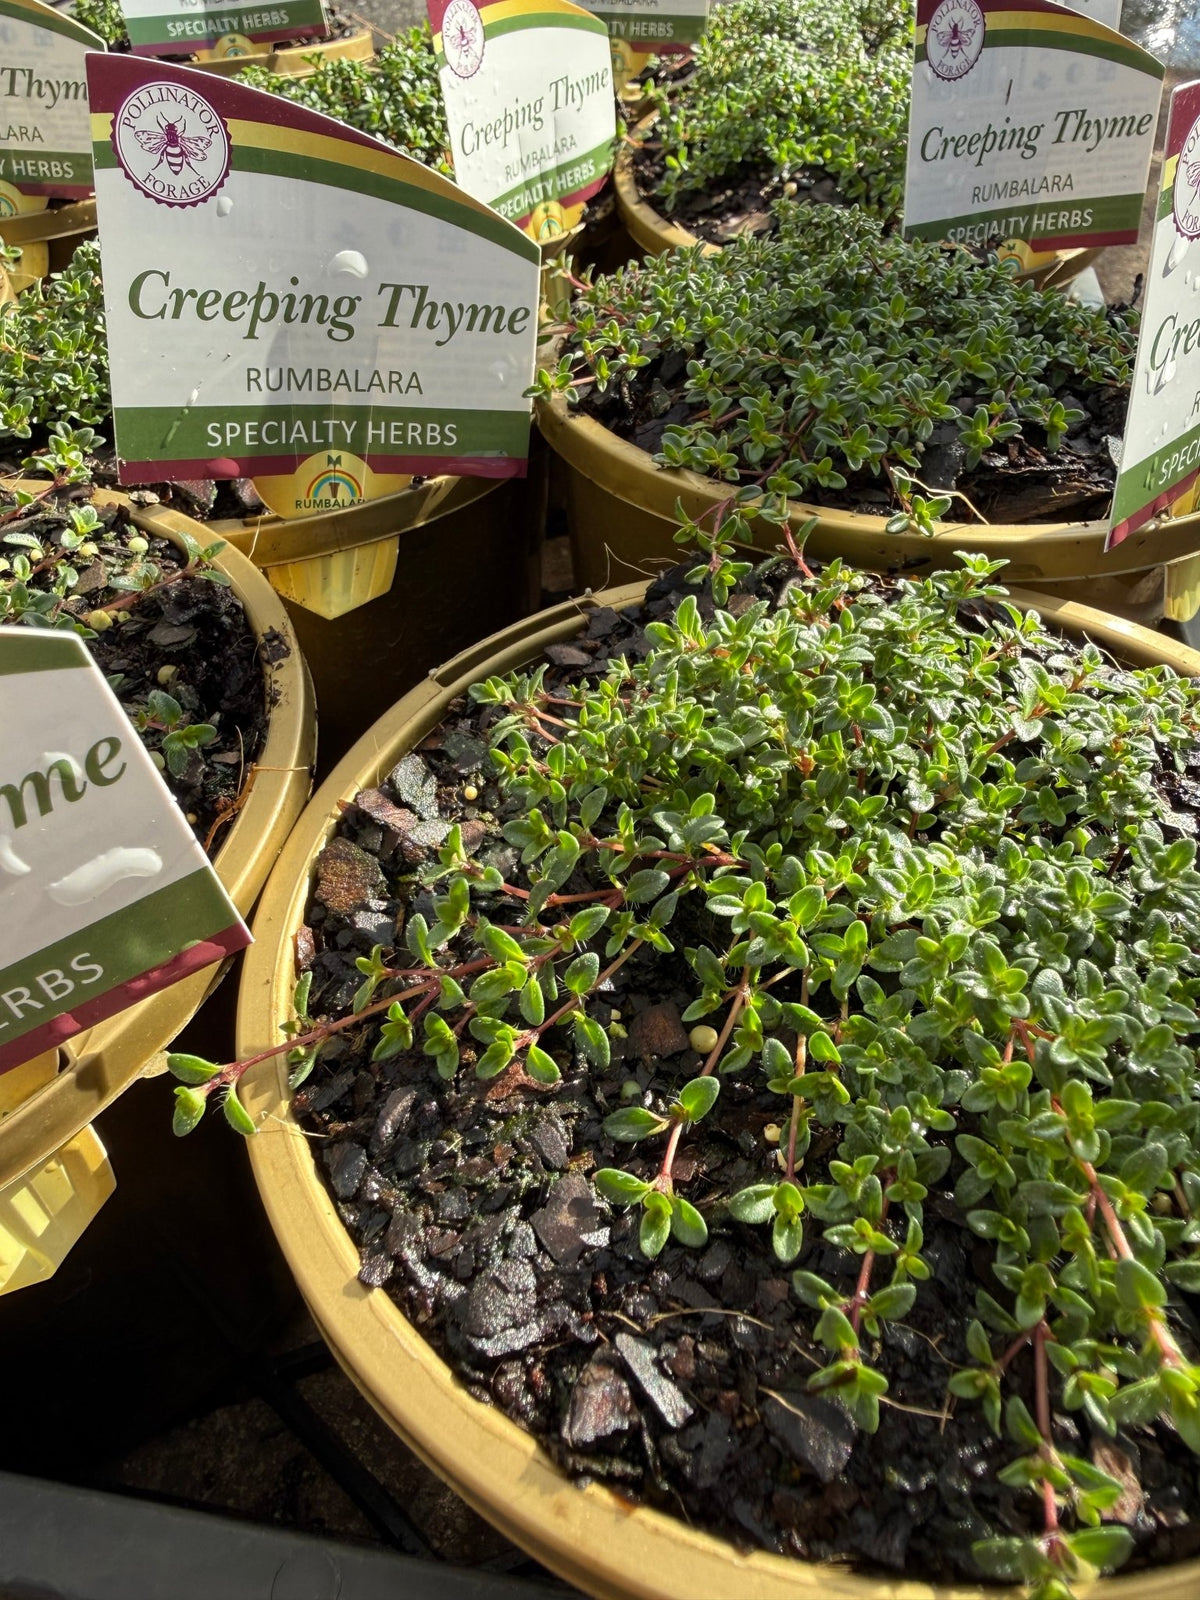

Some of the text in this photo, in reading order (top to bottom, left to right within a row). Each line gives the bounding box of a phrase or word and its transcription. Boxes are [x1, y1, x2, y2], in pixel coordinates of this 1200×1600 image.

[167, 10, 290, 37] SPECIALTY HERBS
[629, 21, 675, 37] HERBS
[931, 0, 982, 32] POLLINATOR
[122, 87, 220, 137] POLLINATOR
[461, 67, 610, 157] Creeping Thyme
[920, 108, 1153, 167] Creeping Thyme
[12, 159, 75, 179] HERBS
[504, 134, 578, 182] RUMBALARA
[142, 171, 211, 199] FORAGE
[556, 159, 596, 191] HERBS
[971, 173, 1075, 205] RUMBALARA
[1031, 208, 1094, 232] HERBS
[128, 269, 531, 347] Creeping Thyme
[246, 367, 424, 395] RUMBALARA
[206, 420, 458, 447] SPECIALTY HERBS
[1158, 437, 1200, 485] SPECI
[0, 952, 105, 1032] RBS
